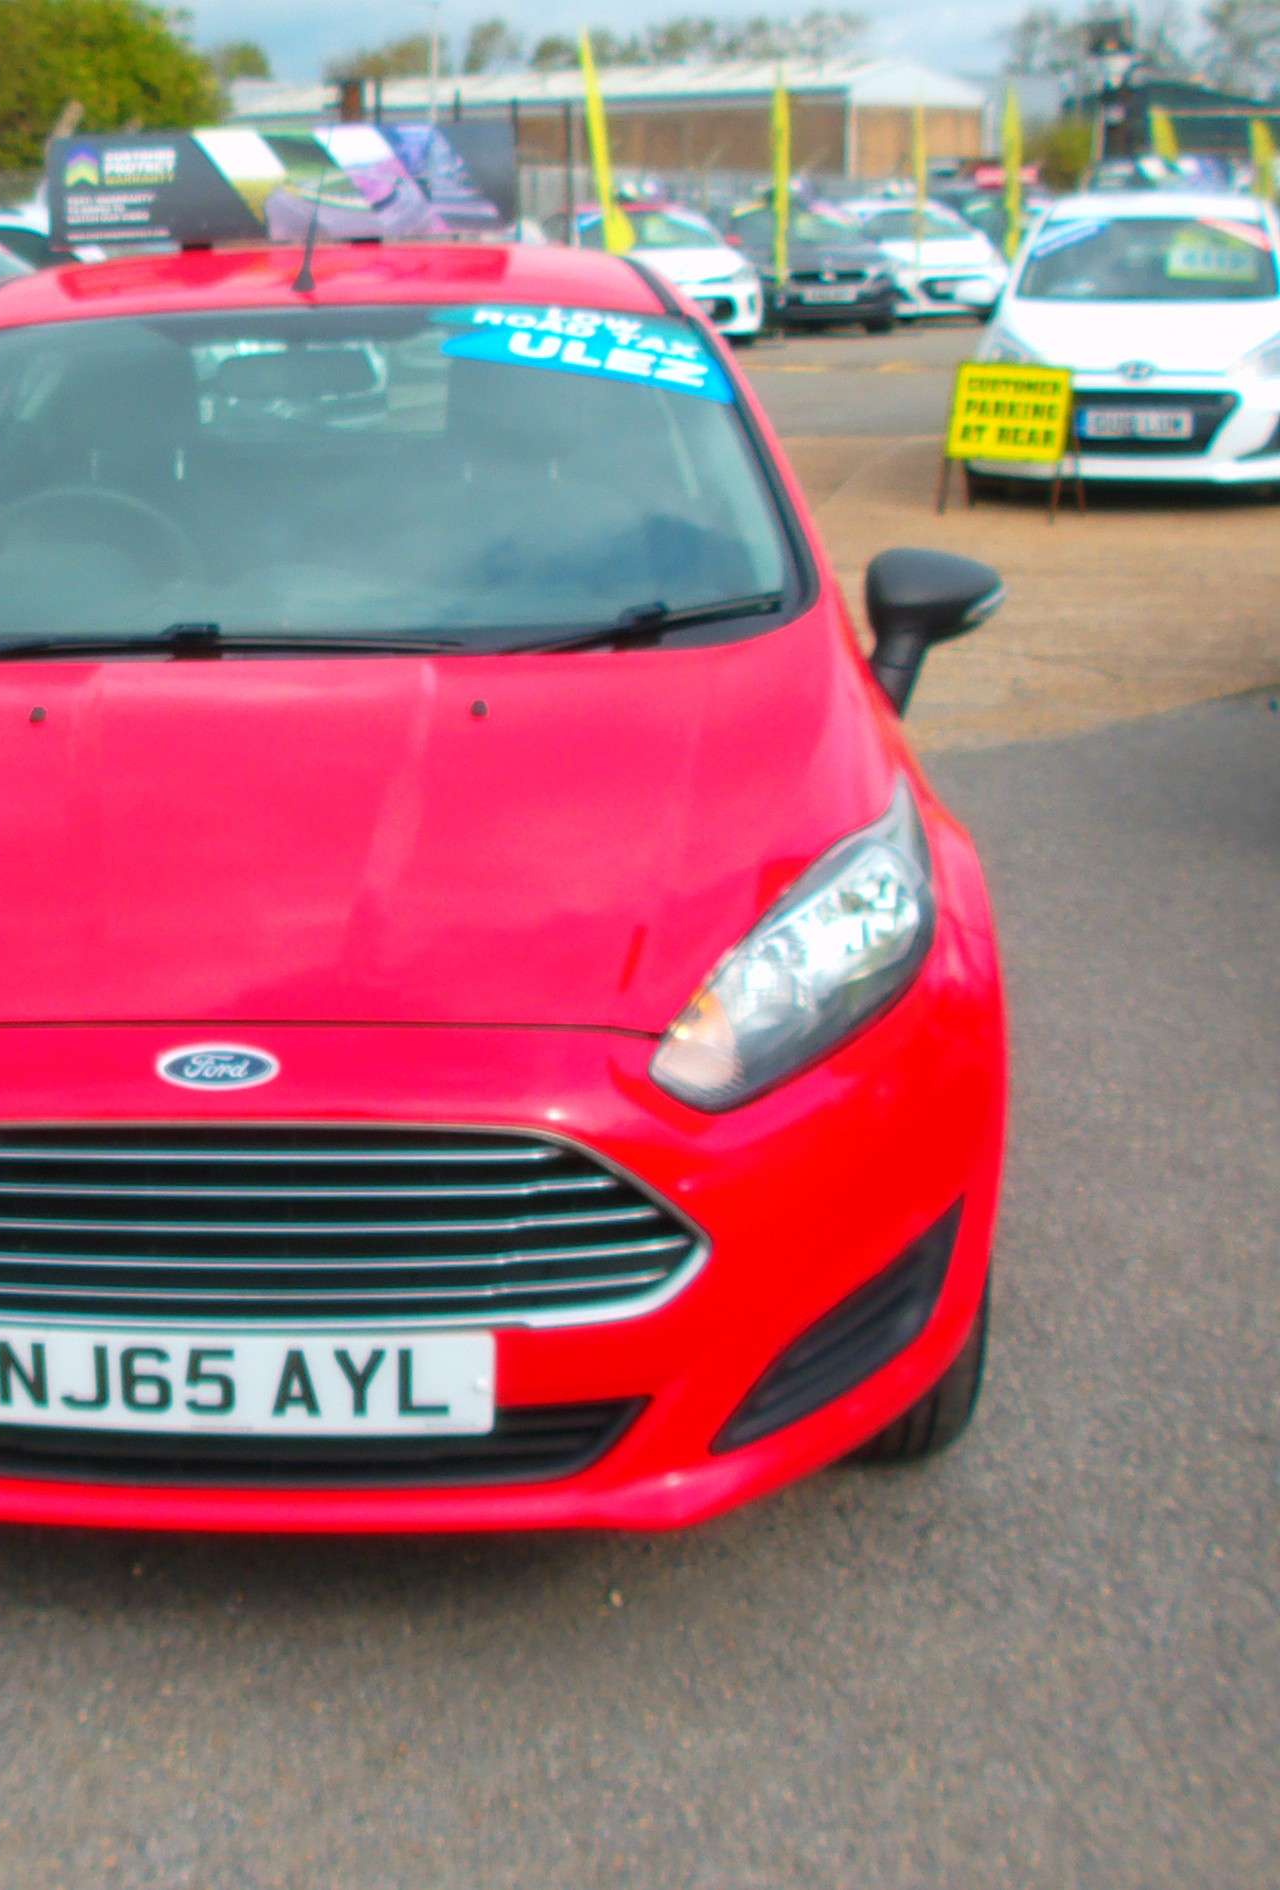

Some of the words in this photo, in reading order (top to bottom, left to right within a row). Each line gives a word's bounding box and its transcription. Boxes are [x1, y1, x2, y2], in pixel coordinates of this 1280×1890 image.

[473, 308, 596, 338] ROAD
[615, 326, 700, 360] TAX
[507, 331, 710, 388] ULEZ
[964, 399, 1059, 421] PARKING
[959, 423, 988, 444] AT
[996, 426, 1056, 449] REAR
[183, 1053, 251, 1079] Ford
[271, 1347, 451, 1418] AYL
